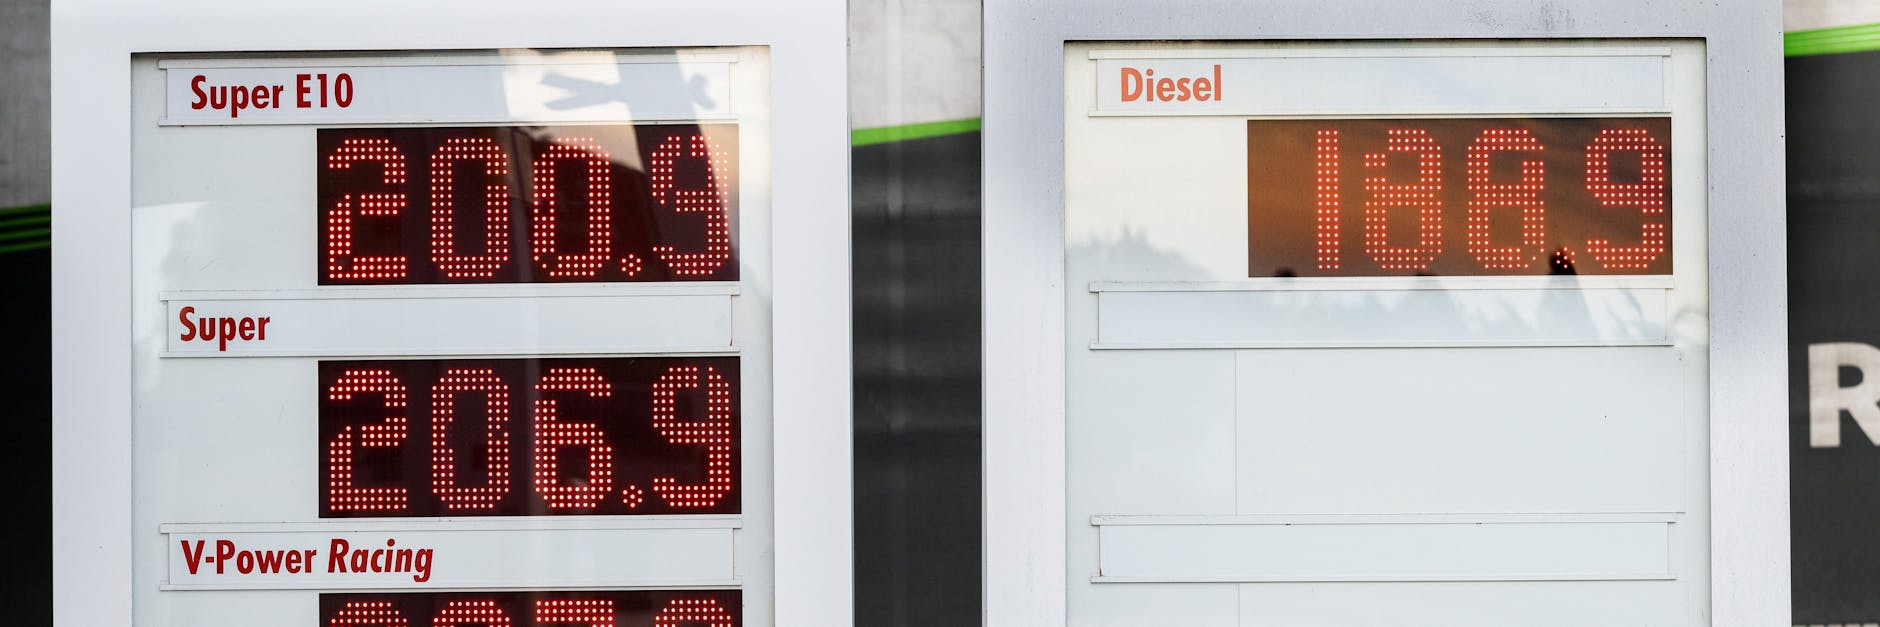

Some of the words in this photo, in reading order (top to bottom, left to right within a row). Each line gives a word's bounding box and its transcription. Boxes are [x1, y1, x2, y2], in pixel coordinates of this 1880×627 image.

[190, 76, 284, 119] Super
[296, 73, 354, 109] E10
[1120, 65, 1222, 102] Diesel
[328, 136, 730, 279] 200.9
[1317, 129, 1664, 269] 188.9
[179, 307, 270, 351] Super
[329, 368, 731, 511] 206.9
[181, 540, 317, 575] V-Power
[327, 538, 434, 582] Racing
